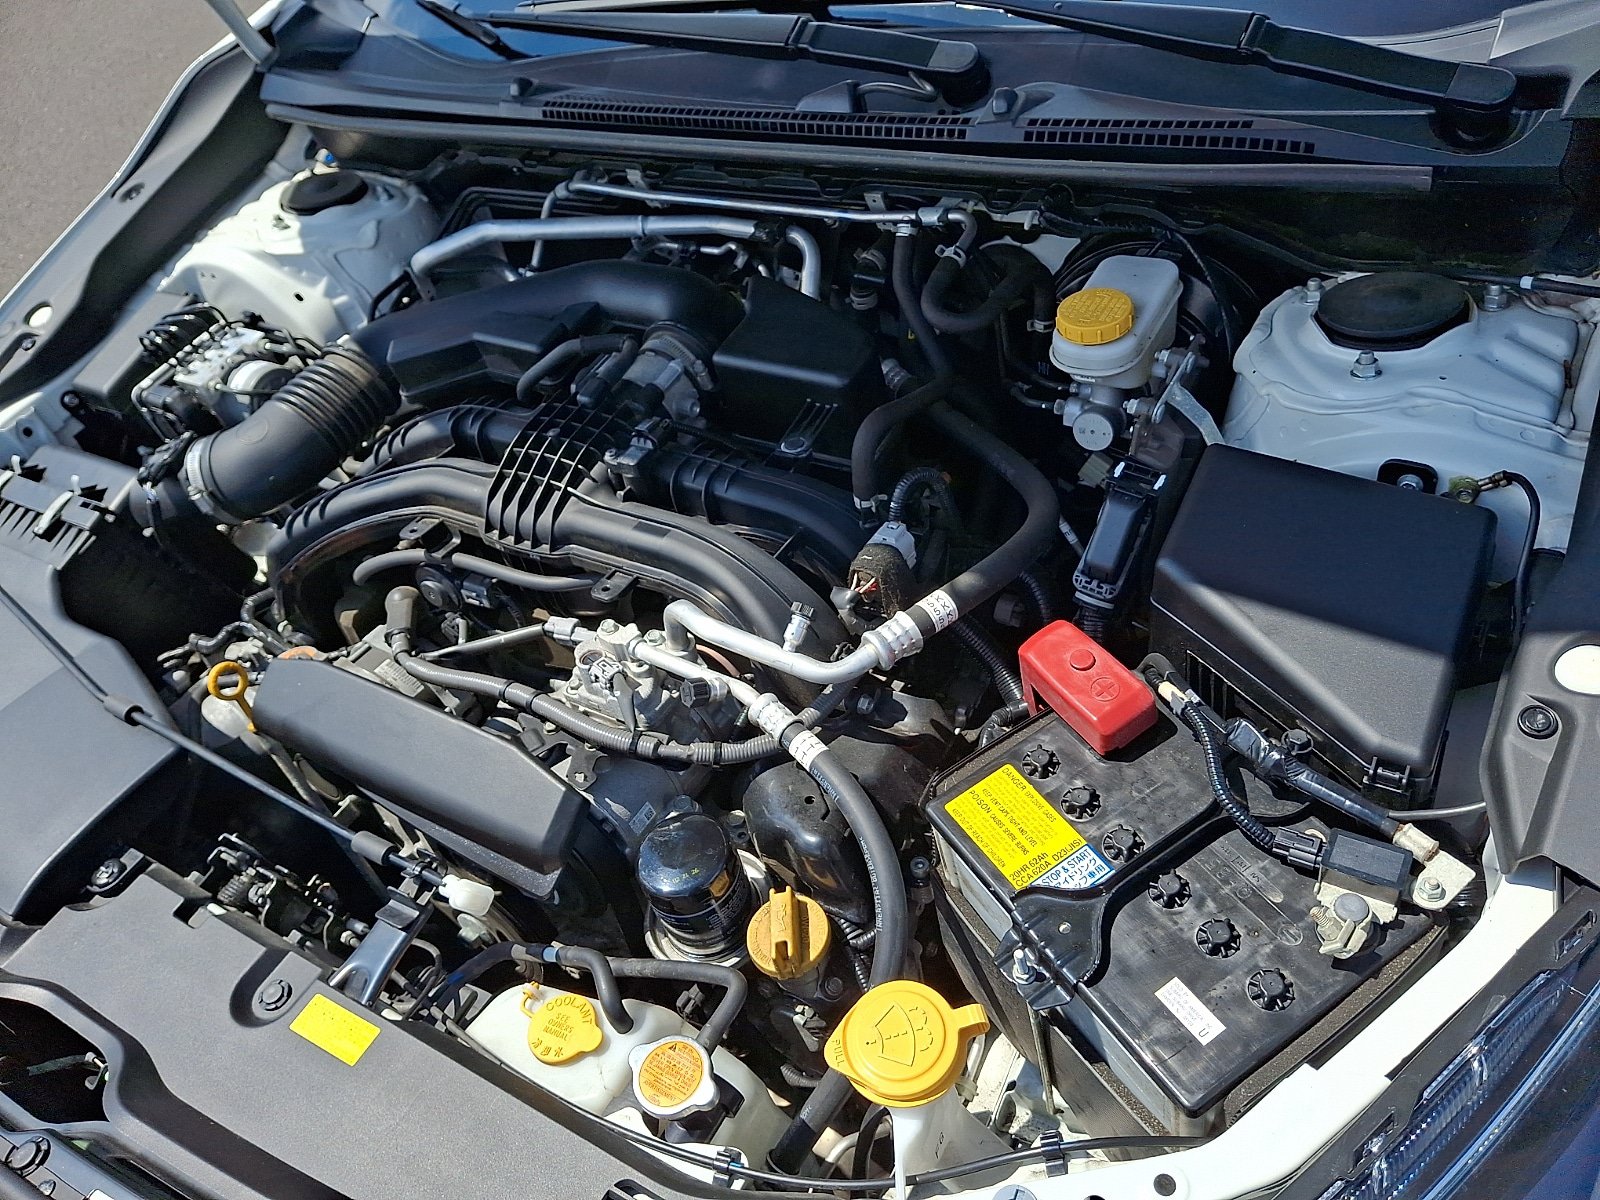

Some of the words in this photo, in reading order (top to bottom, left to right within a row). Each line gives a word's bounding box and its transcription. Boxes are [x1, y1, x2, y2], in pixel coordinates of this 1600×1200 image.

[1001, 767, 1027, 791] DANGER
[1023, 790, 1044, 810] EXPLOSIVE
[967, 789, 992, 814] POISON
[989, 813, 1005, 828] CAUSES
[1002, 827, 1017, 842] SEVERE
[1016, 825, 1027, 836] AND
[1024, 833, 1038, 847] LEVEL
[1008, 863, 1030, 881] 20HR
[1026, 851, 1049, 868] 62Ah
[1014, 871, 1033, 887] CCA
[1030, 859, 1052, 876] 620A
[1050, 837, 1083, 861] D23(JIS)
[1042, 868, 1062, 886] STOP
[1062, 865, 1069, 874] &
[1070, 849, 1092, 870] START
[546, 997, 593, 1025] COOLANT
[556, 1012, 568, 1023] SEE
[543, 1025, 568, 1041] MANUAL
[548, 1019, 573, 1035] OWNERS
[1198, 1028, 1209, 1038] U
[831, 1038, 845, 1067] PULL
